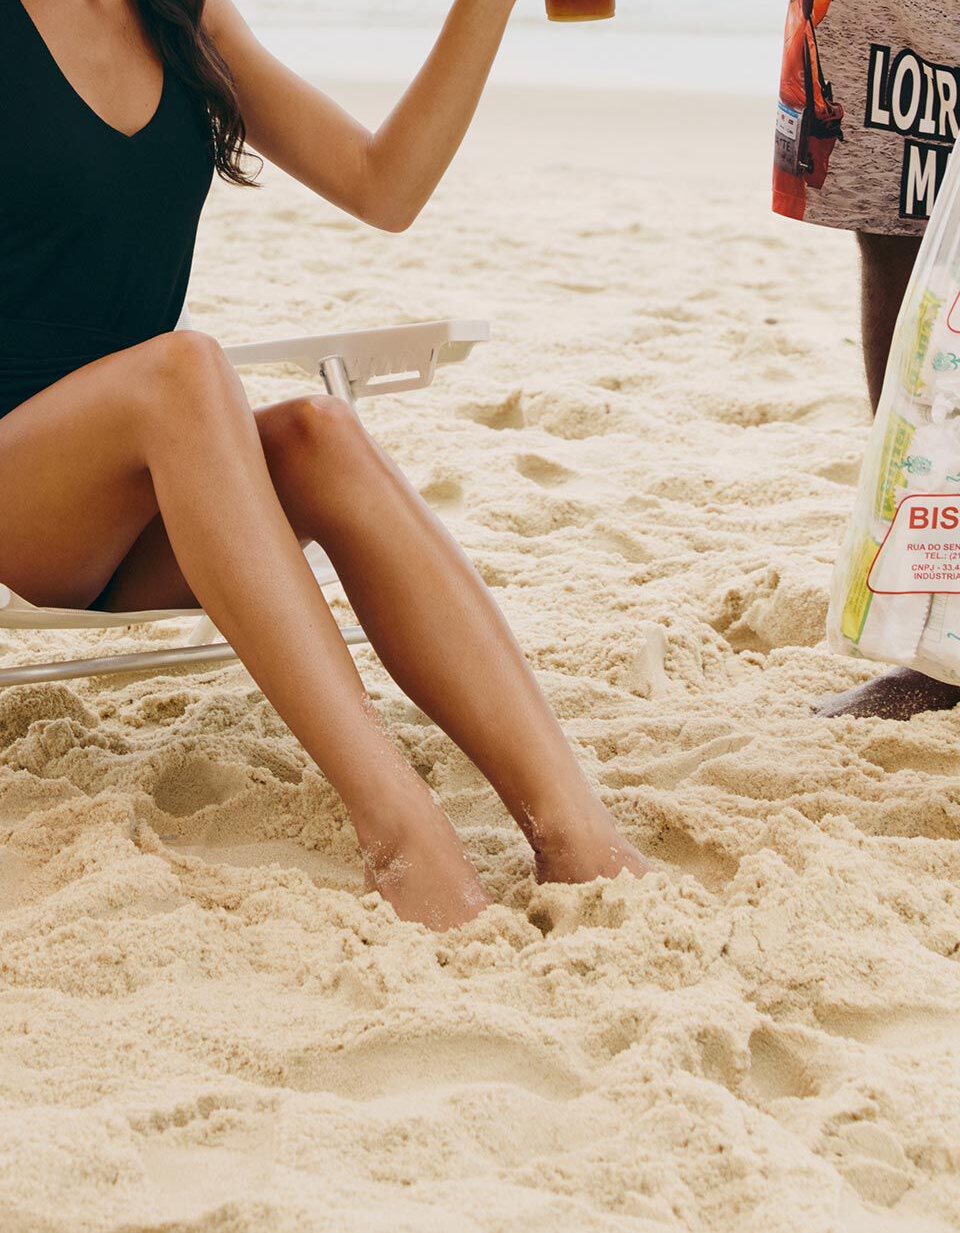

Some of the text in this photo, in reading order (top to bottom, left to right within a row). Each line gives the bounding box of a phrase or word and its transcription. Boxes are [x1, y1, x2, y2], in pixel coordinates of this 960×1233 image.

[905, 144, 952, 217] M
[908, 506, 959, 530] BIS
[906, 543, 926, 551] RUA
[927, 543, 942, 551] DO
